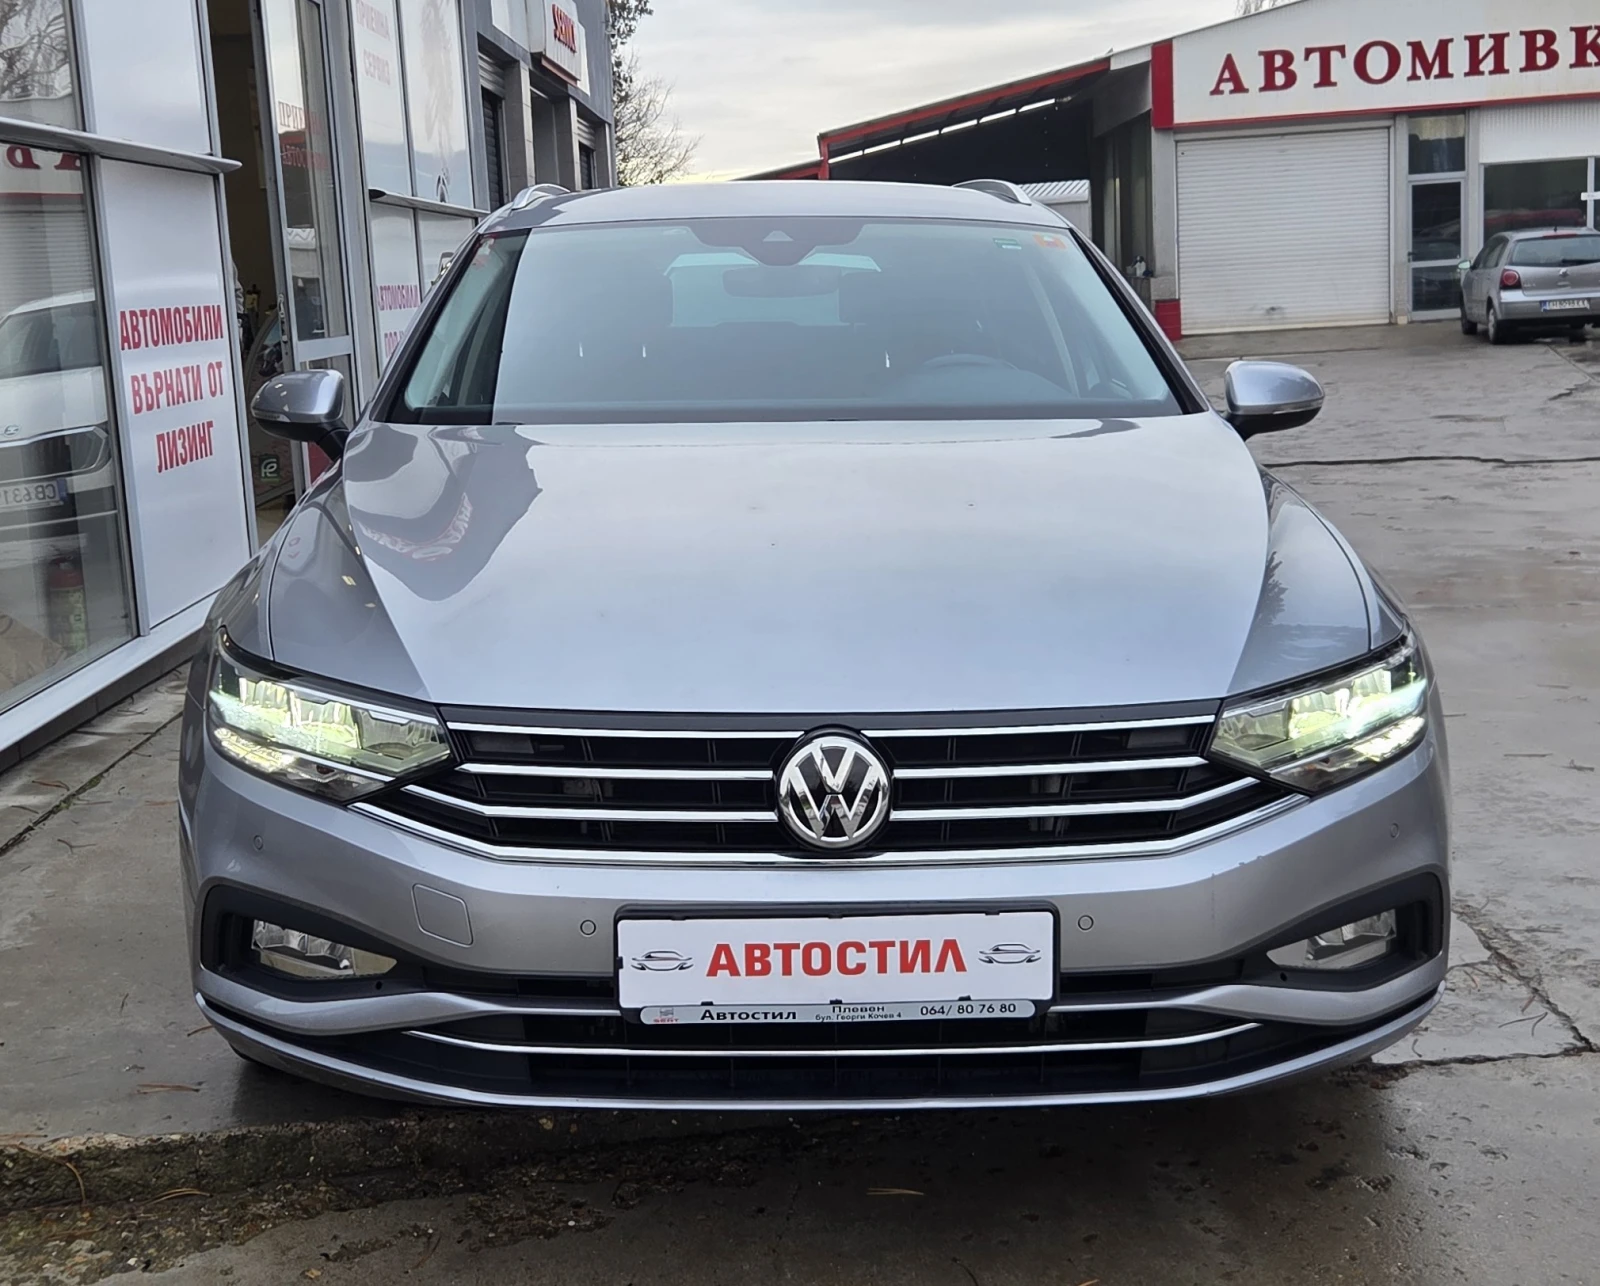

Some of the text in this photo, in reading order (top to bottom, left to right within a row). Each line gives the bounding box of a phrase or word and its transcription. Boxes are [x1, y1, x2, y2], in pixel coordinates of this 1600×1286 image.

[120, 304, 224, 351] АВТОМОБИЛИ
[130, 361, 224, 415] ВЪРНАТИ ОТ
[156, 420, 214, 473] ЛИЗИНГ
[706, 938, 968, 977] АВТОСТИЛ
[920, 1003, 1017, 1016] 064/ 80 76 80
